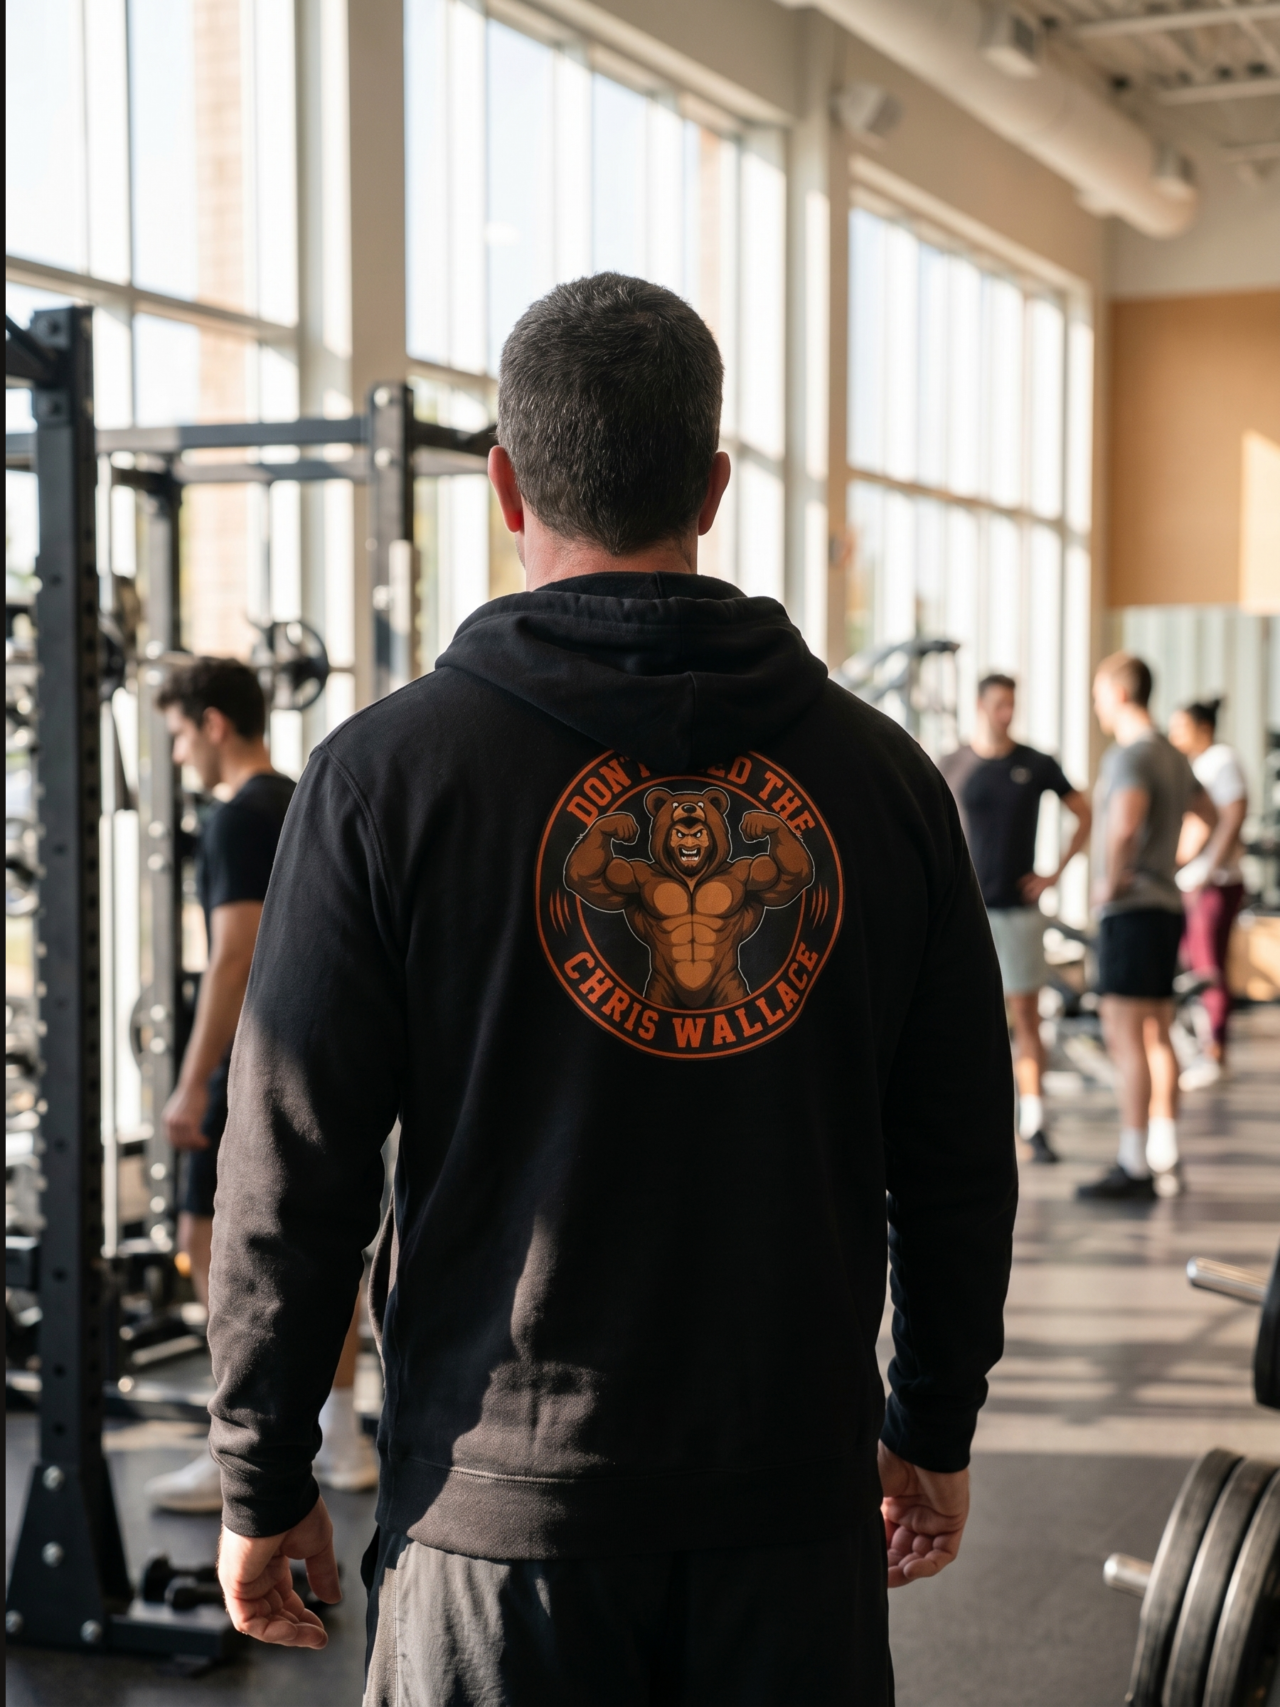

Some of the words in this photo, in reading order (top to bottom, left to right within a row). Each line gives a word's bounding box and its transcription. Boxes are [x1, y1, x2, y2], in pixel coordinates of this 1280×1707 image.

[759, 771, 816, 835] THE
[564, 951, 659, 1041] CHRIS
[673, 941, 819, 1048] WALLACE
